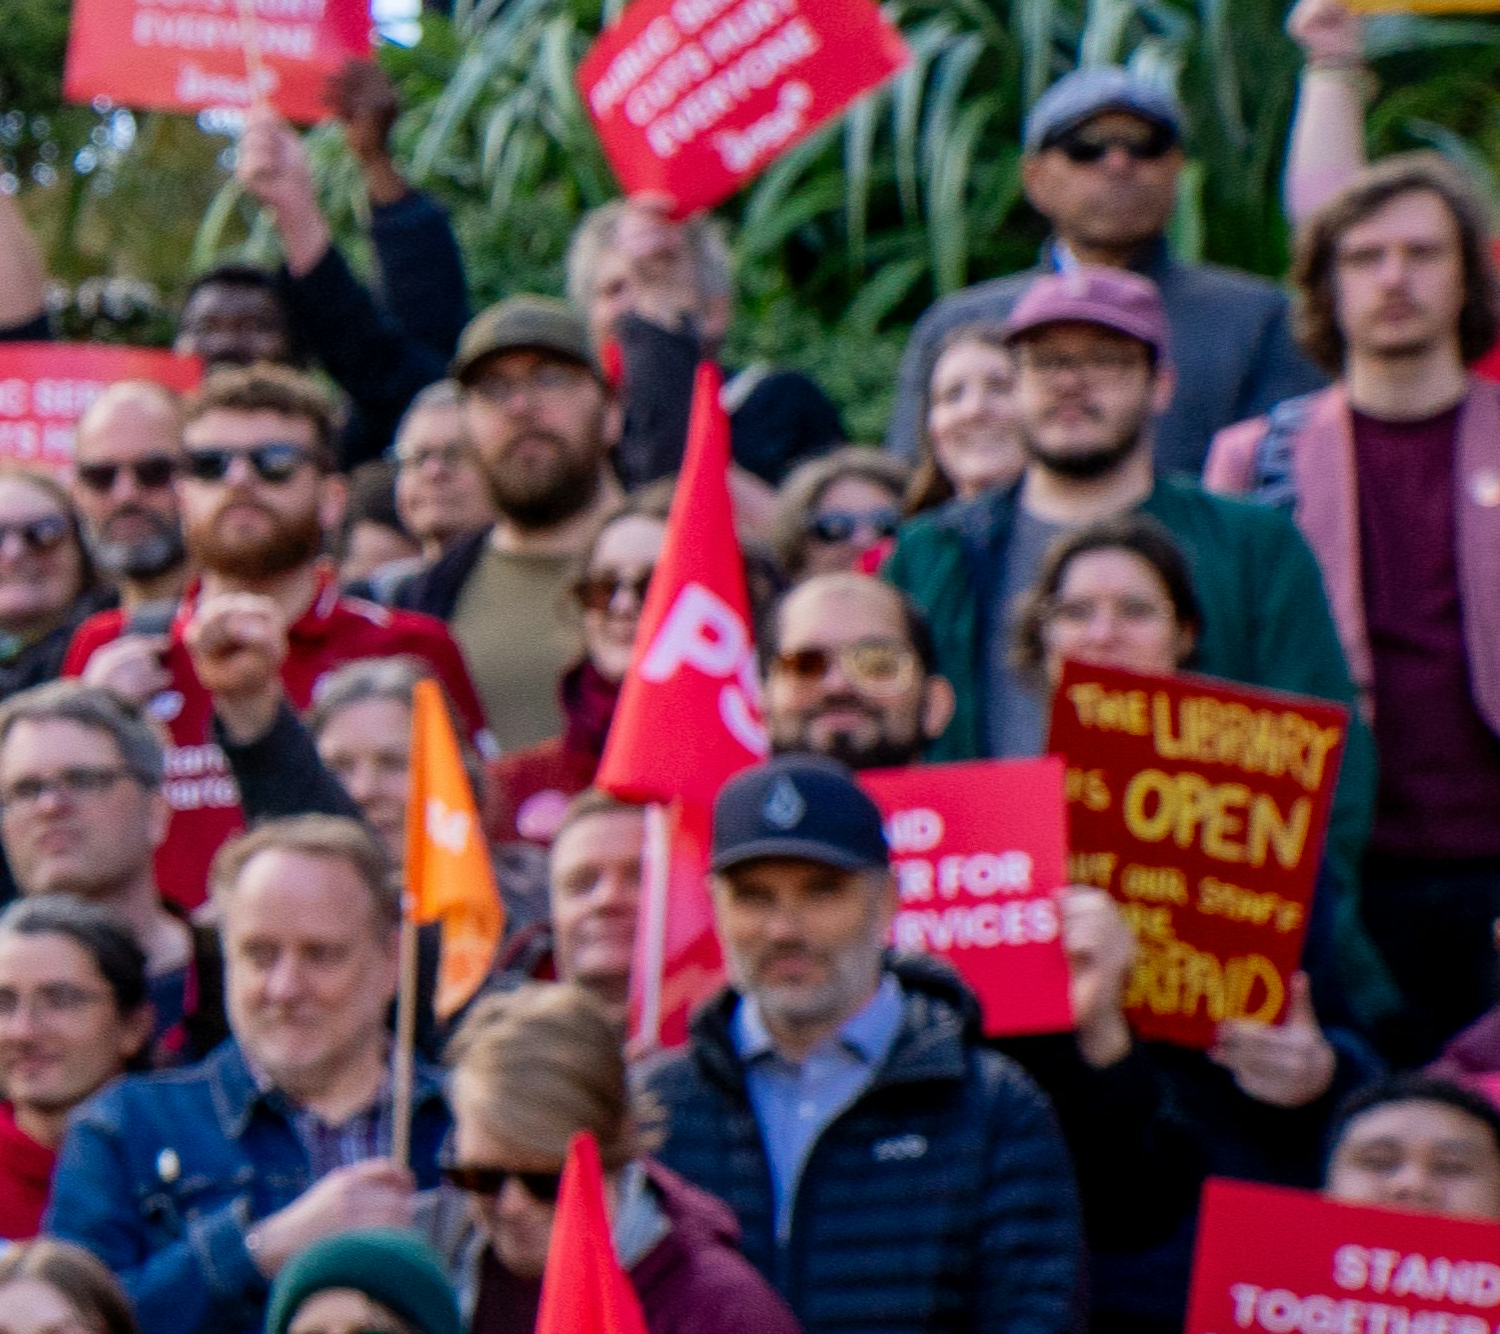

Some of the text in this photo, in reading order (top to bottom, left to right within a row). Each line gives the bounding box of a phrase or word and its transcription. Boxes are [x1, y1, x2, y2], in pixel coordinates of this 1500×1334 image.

[595, 20, 675, 114] PUBLIC
[631, 47, 706, 120] CUTS
[652, 22, 816, 152] EVERYONE
[1071, 685, 1339, 787] THE LIBRARY
[1128, 770, 1308, 866] OPEN
[938, 851, 1032, 897] FOR
[896, 900, 1058, 951] RVICES
[1332, 1243, 1500, 1308] STAND
